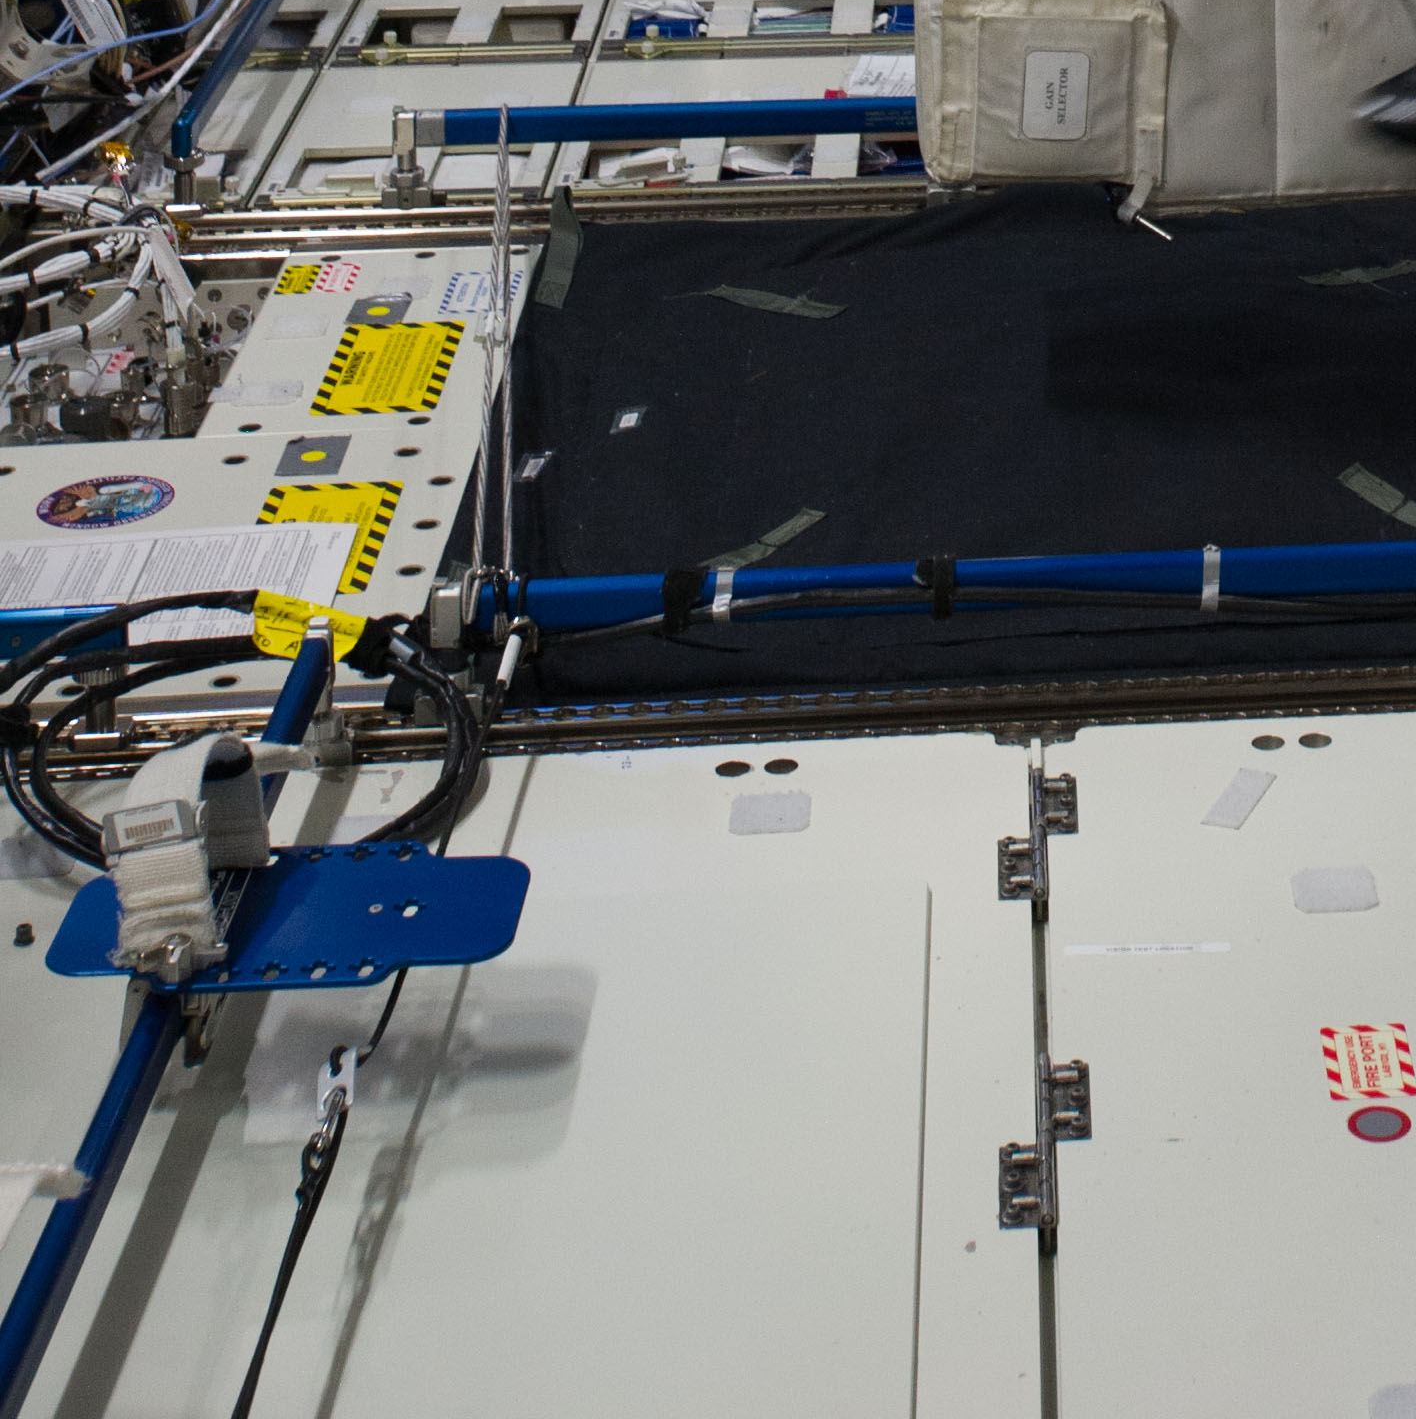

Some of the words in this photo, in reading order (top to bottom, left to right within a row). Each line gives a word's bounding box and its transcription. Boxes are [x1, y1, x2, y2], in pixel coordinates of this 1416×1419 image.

[1044, 82, 1055, 110] GAIN
[1056, 67, 1069, 125] SELECTOR
[1344, 1034, 1354, 1048] USE
[1359, 1034, 1376, 1062] PORT
[1364, 1064, 1381, 1088] FIRE
